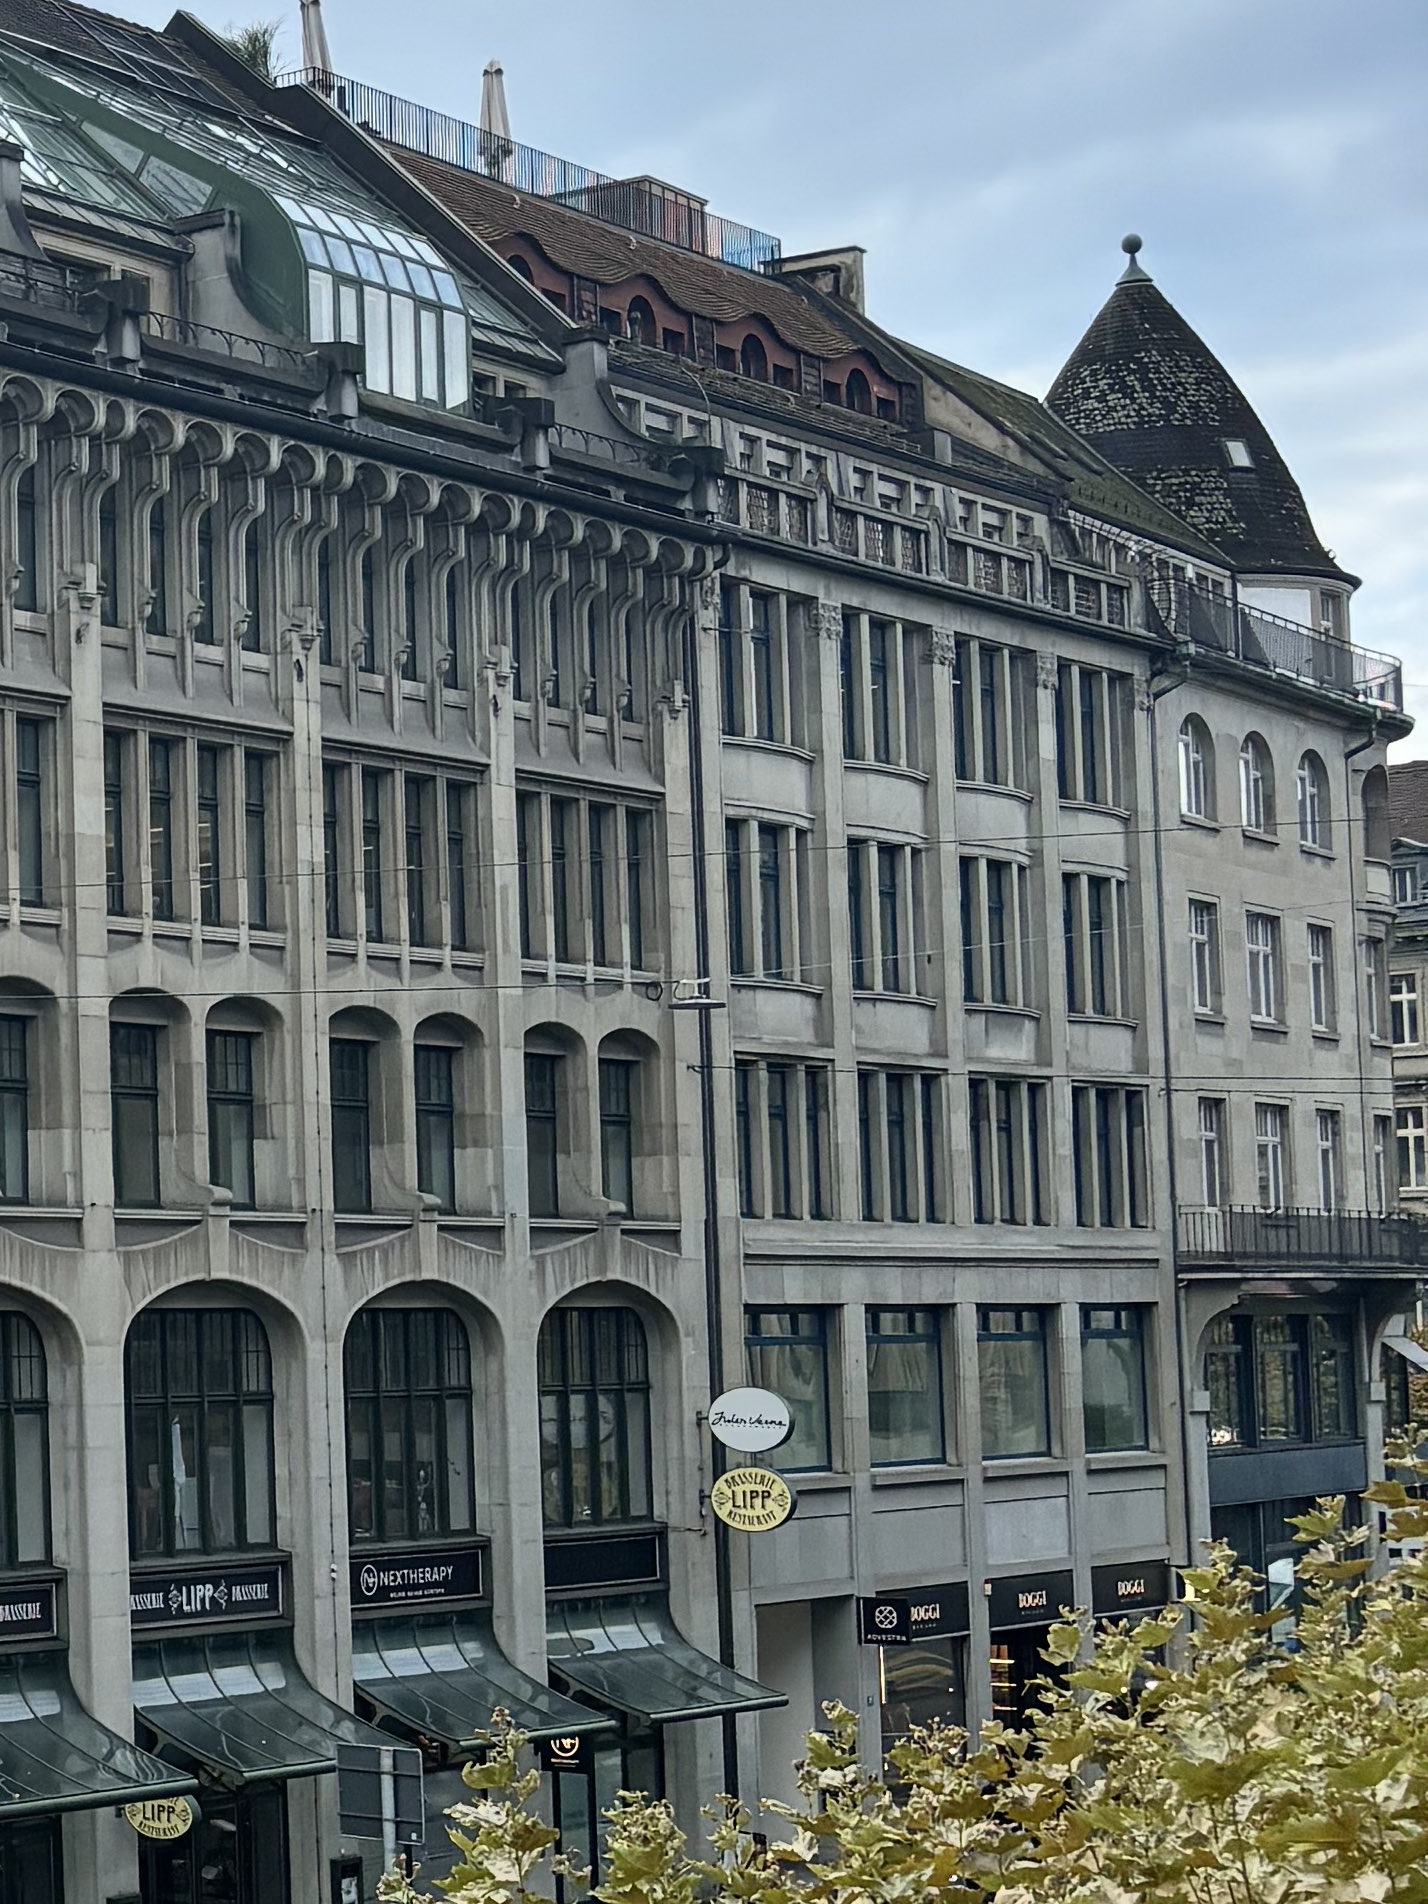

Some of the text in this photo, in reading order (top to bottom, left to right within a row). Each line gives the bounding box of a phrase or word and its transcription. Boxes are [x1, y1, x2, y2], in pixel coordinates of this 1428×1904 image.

[724, 1471, 777, 1491] BRASSERIE
[731, 1489, 772, 1511] LIPP
[726, 1509, 777, 1527] RESTAURANT
[379, 1565, 453, 1587] NEXTHERAPY
[1118, 1579, 1145, 1596] BOGGI
[182, 1584, 214, 1613] LIPP
[1018, 1590, 1047, 1608] BOGGI
[142, 1802, 175, 1824] LIPP
